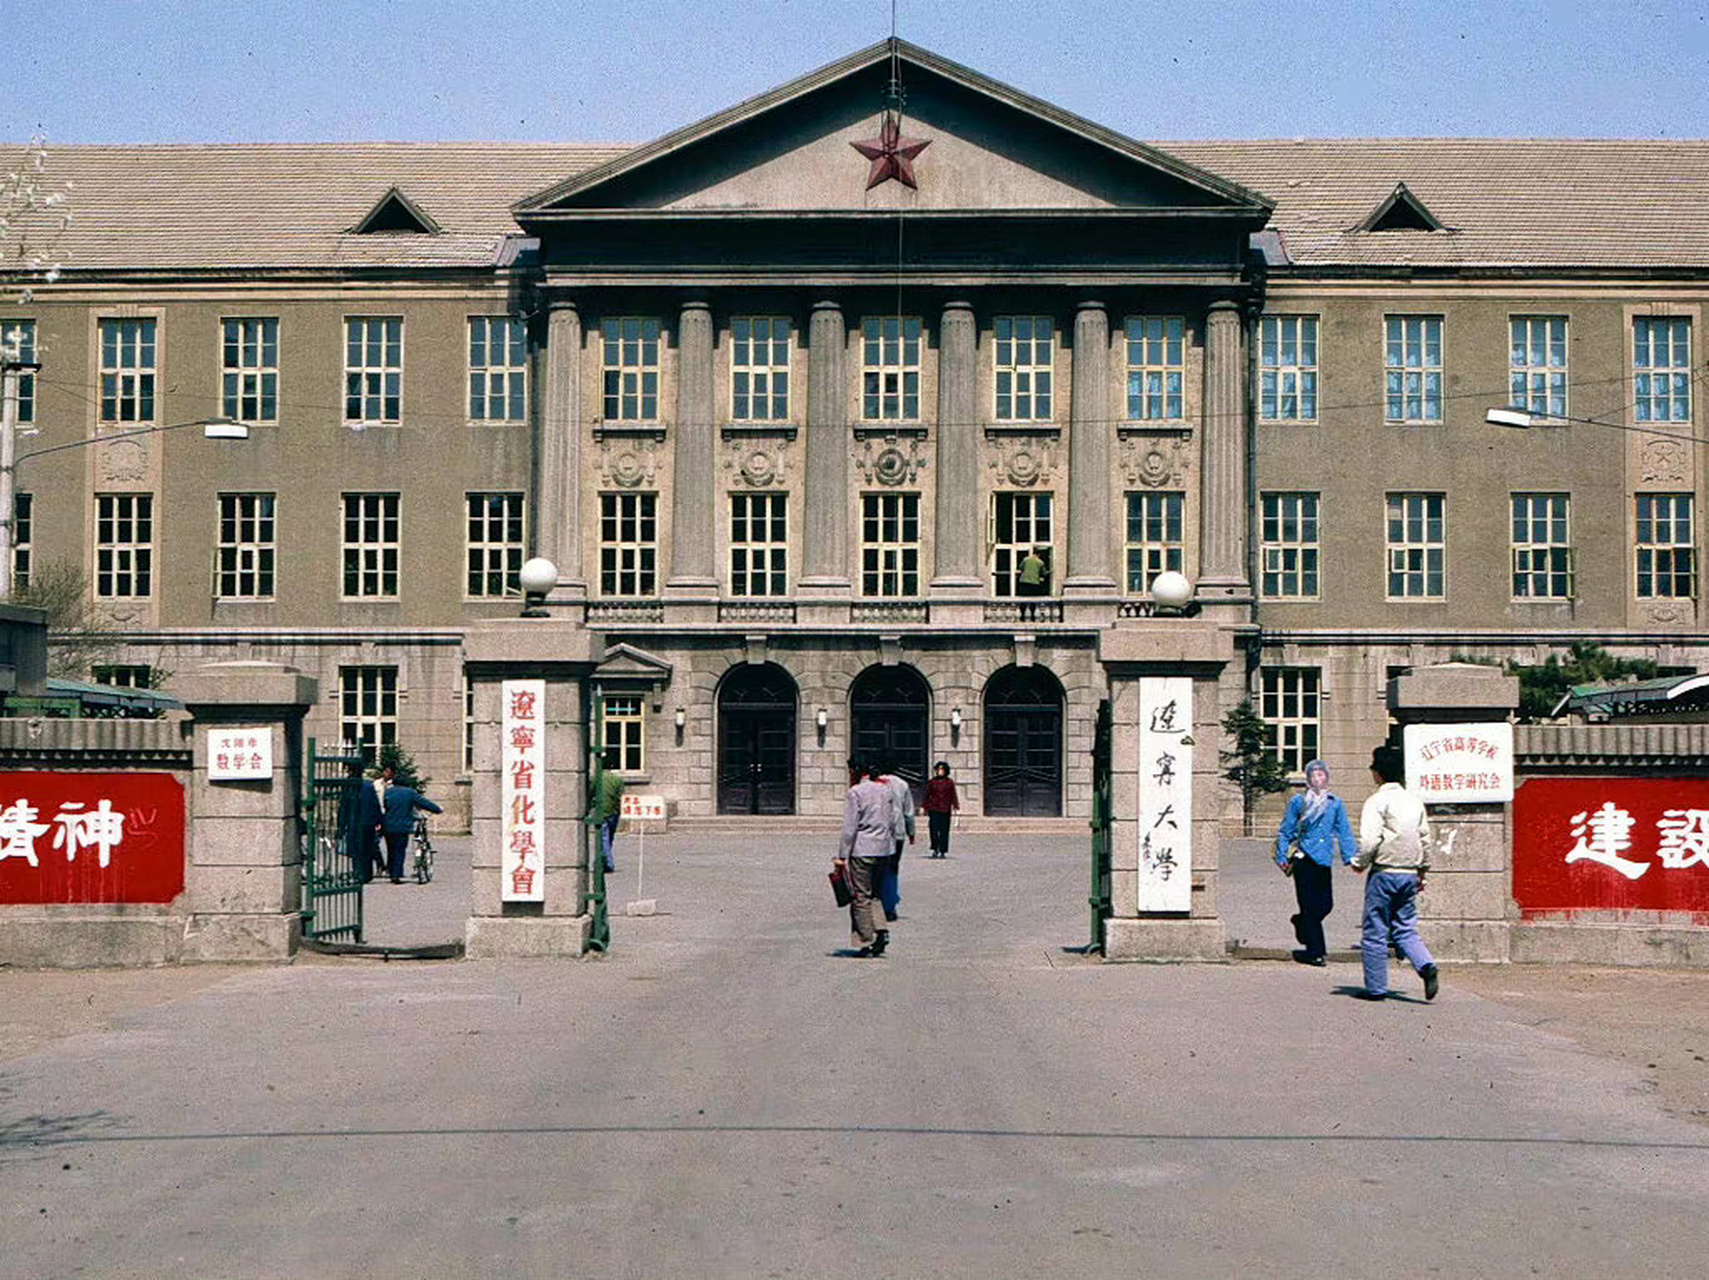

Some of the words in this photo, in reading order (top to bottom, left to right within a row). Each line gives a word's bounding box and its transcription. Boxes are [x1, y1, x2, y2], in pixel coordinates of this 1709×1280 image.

[1420, 737, 1499, 761] 辽宁省高等学校
[1420, 773, 1500, 790] 外语教学研究会
